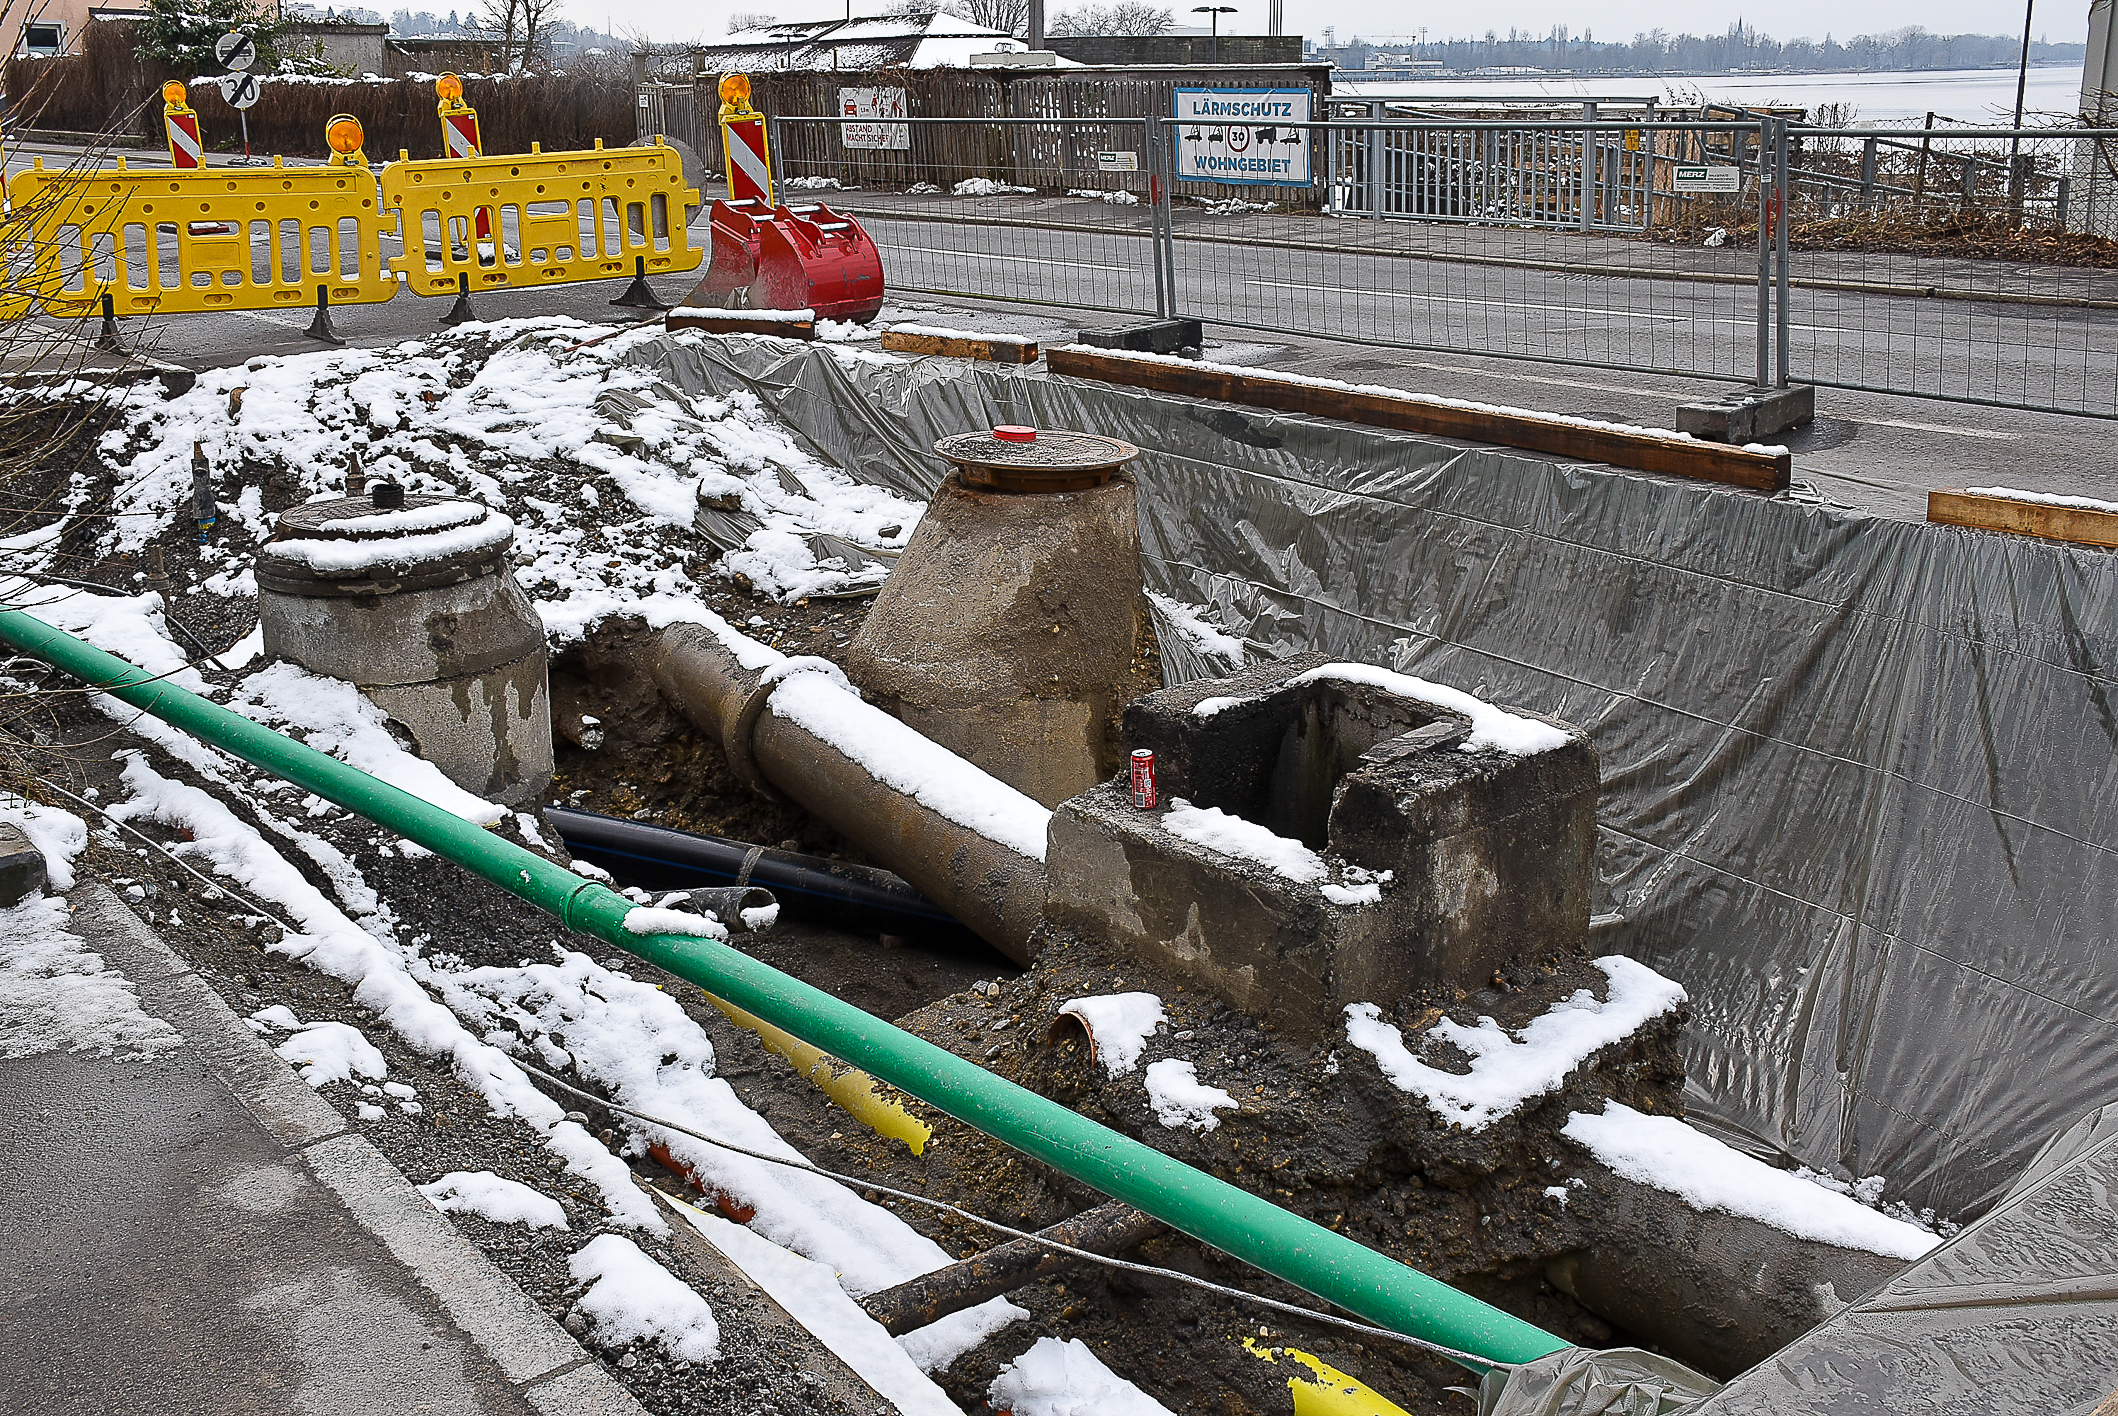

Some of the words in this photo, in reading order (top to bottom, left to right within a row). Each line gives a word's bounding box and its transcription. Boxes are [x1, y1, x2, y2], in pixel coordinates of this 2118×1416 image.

[1193, 98, 1292, 117] LÄRMSCHUTZ
[1232, 131, 1245, 142] 30
[1194, 155, 1292, 173] WOHNGEBIET
